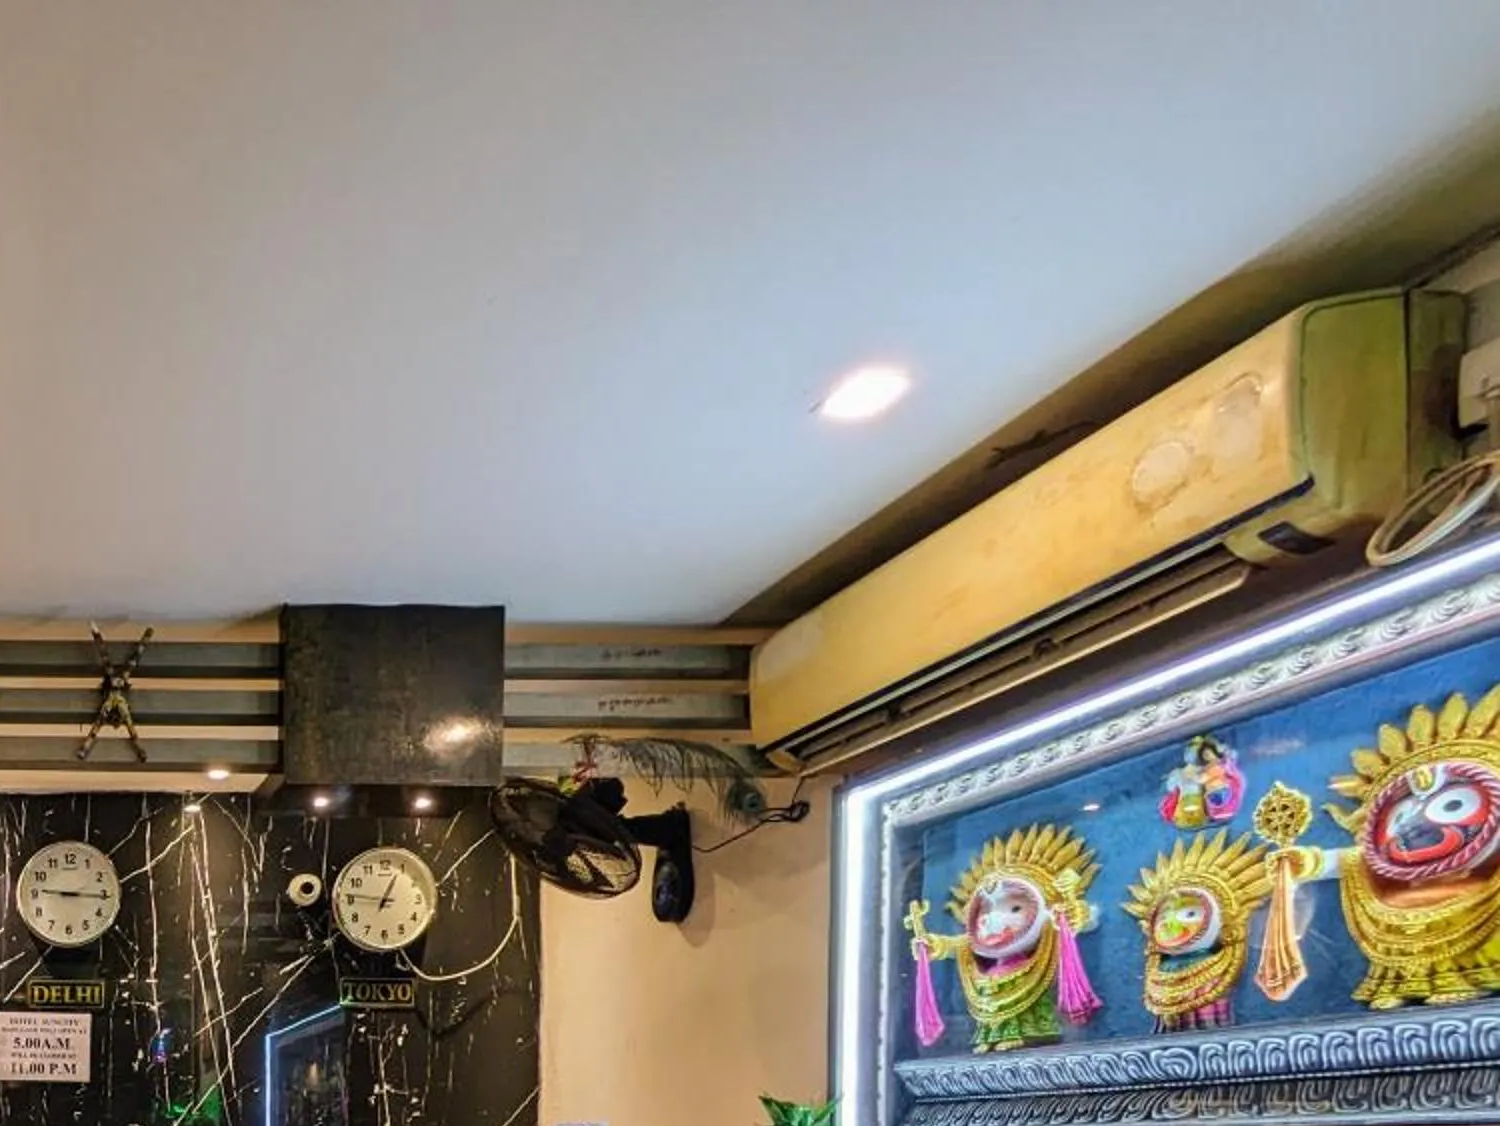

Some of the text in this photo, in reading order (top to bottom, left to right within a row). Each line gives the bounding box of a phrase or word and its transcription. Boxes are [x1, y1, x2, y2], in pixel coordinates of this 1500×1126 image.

[48, 858, 58, 869] 11
[64, 853, 76, 864] 12
[85, 858, 90, 869] 1
[363, 865, 373, 875] 11
[400, 863, 405, 873] 1
[34, 871, 47, 881] 10
[96, 871, 103, 882] 2
[350, 877, 362, 888] 10
[31, 888, 39, 899] 9
[36, 907, 42, 917] 8
[95, 907, 102, 917] 4
[351, 912, 359, 922] 8
[409, 911, 417, 922] 4
[48, 920, 55, 930] 7
[65, 924, 73, 935] 6
[83, 919, 90, 930] 5
[363, 925, 371, 935] 7
[398, 923, 405, 934] 5
[381, 929, 388, 939] 6
[32, 985, 102, 1003] DELHI
[343, 982, 411, 1000] TOKYO
